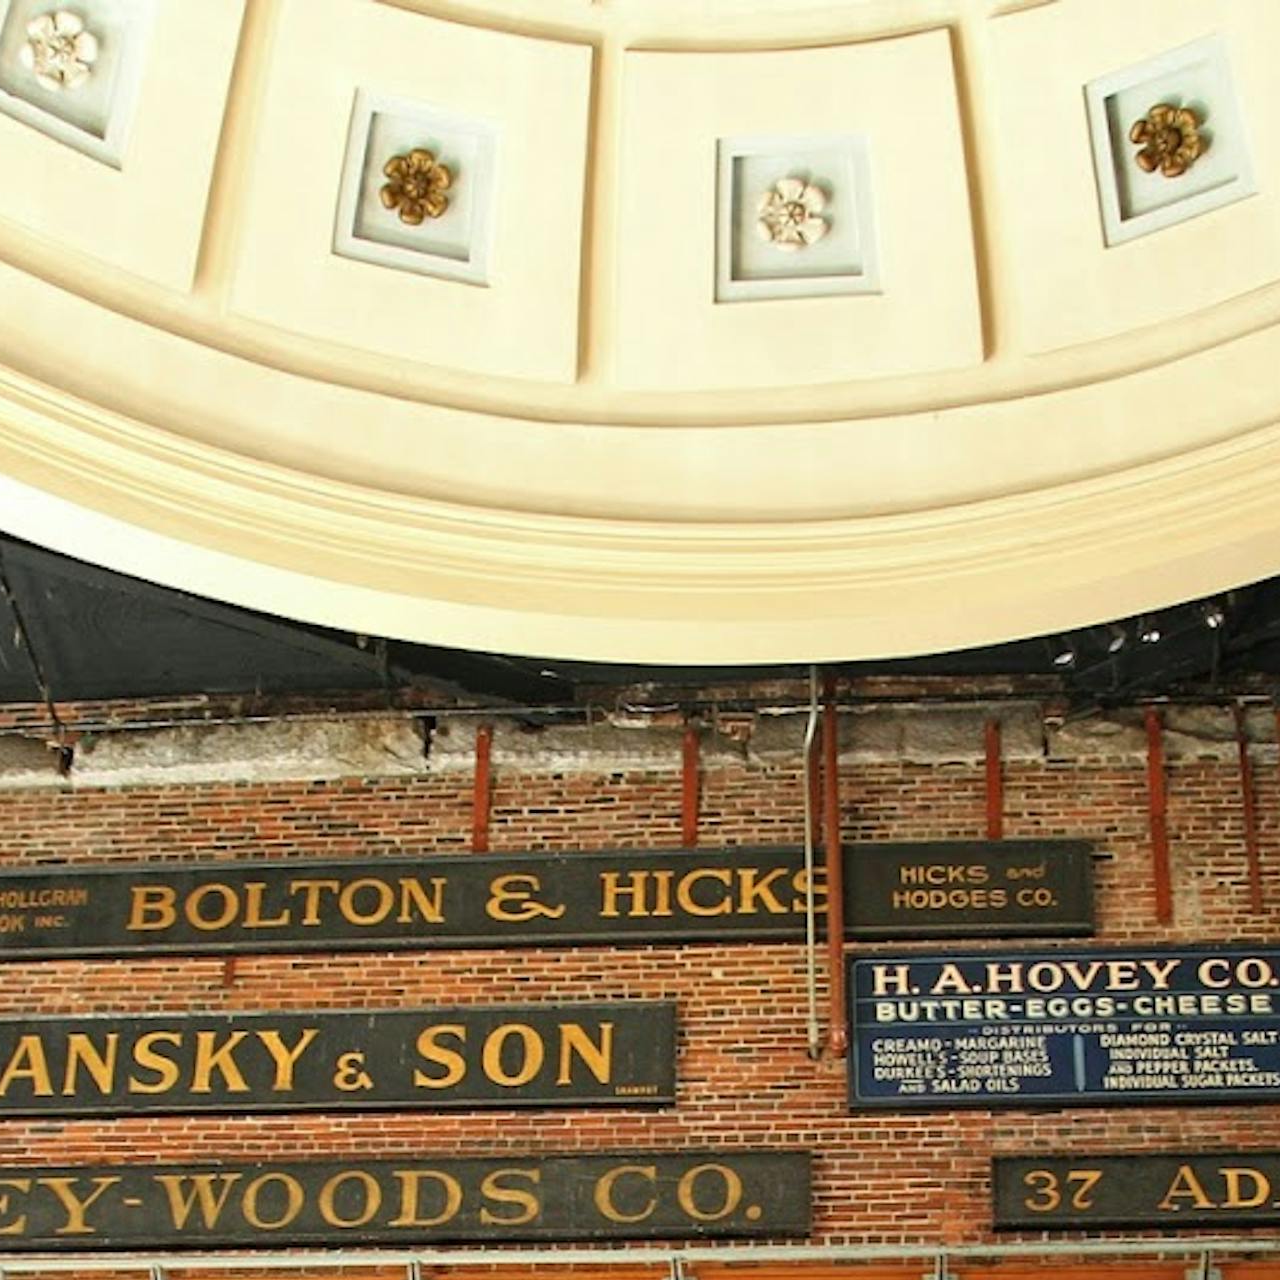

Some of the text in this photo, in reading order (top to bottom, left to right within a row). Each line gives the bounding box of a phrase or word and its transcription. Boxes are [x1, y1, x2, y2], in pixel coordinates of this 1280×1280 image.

[900, 861, 1047, 885] HICKS and
[127, 867, 830, 931] BOLTON & HICKS
[893, 888, 1059, 909] HODGES CO.
[1198, 958, 1280, 989] CO.
[982, 1022, 1172, 1036] DISTRIBUTORS FOR
[1100, 1033, 1170, 1048] DIAMOND
[1175, 1031, 1238, 1046] CRYSTAL
[333, 1052, 375, 1092] &
[414, 1023, 613, 1089] SON
[1194, 1046, 1229, 1060] SALT
[1136, 1060, 1191, 1075] PEPPER
[931, 1079, 981, 1093] SALAD
[985, 1077, 1020, 1093] OILS
[594, 1164, 762, 1222] CO.
[1023, 1170, 1102, 1211] 37
